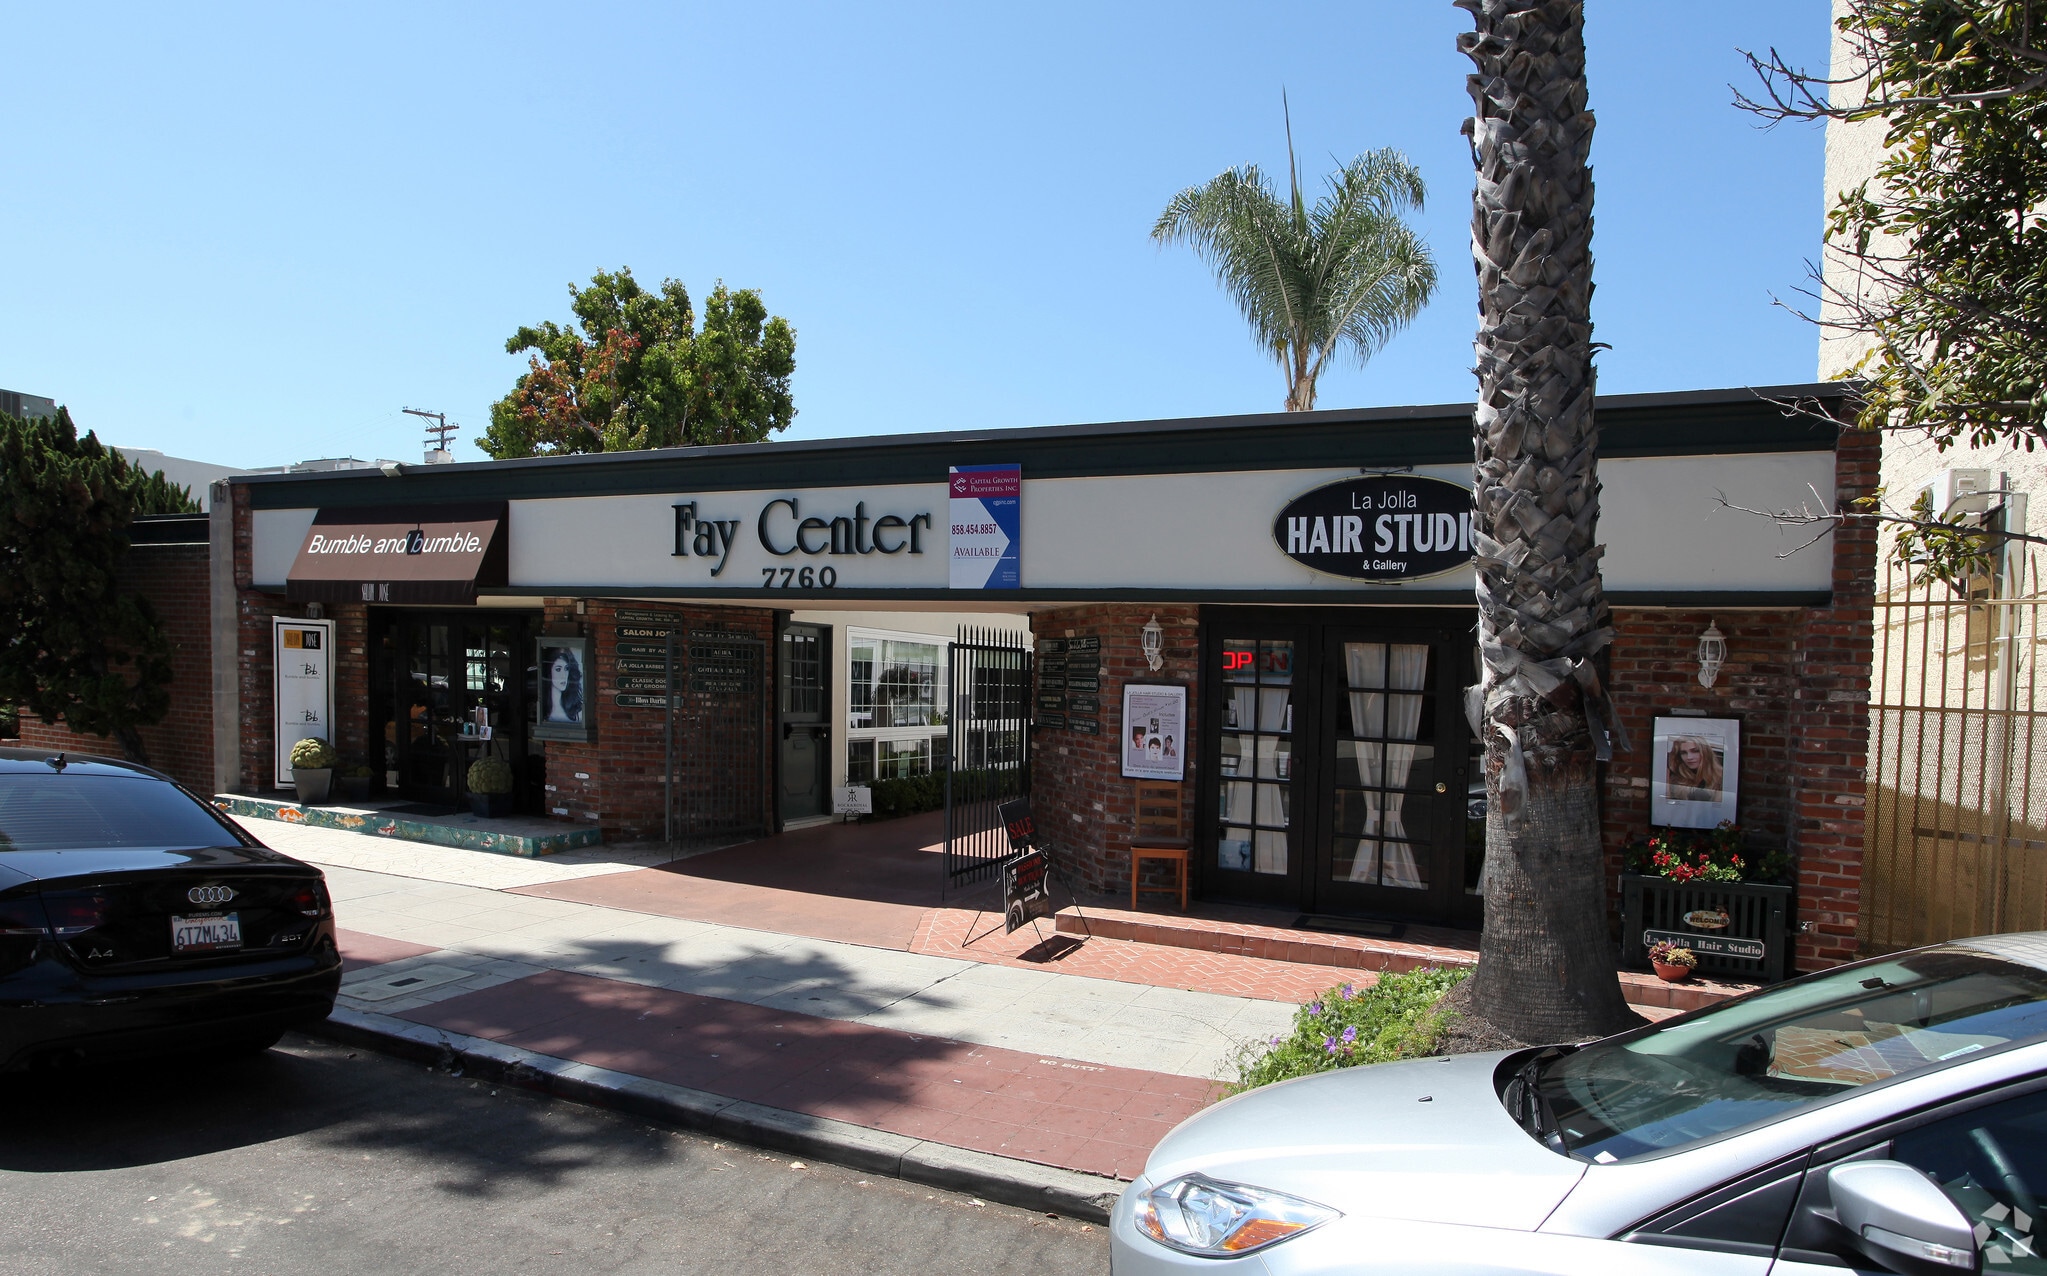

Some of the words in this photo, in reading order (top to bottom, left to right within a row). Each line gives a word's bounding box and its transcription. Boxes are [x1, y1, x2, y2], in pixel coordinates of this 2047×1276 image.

[1352, 491, 1372, 510] La
[1377, 490, 1417, 509] Jolla
[671, 501, 741, 577] Fay
[758, 498, 931, 556] Center
[951, 523, 997, 535] 858.454.8857
[1287, 515, 1363, 554] HAIR
[1374, 512, 1474, 553] STUDI
[307, 534, 371, 554] Bumble
[373, 532, 411, 554] and
[411, 532, 482, 554] bumble.
[1362, 560, 1370, 570] &
[1372, 559, 1407, 572] Gallery
[762, 566, 837, 589] 7760
[623, 628, 653, 636] SALON
[1008, 816, 1034, 840] SALE
[176, 924, 238, 945] 6TZM434
[1646, 934, 1660, 944] La
[1697, 940, 1722, 951] Hair
[1727, 943, 1761, 955] Studio
[87, 947, 114, 959] A4
